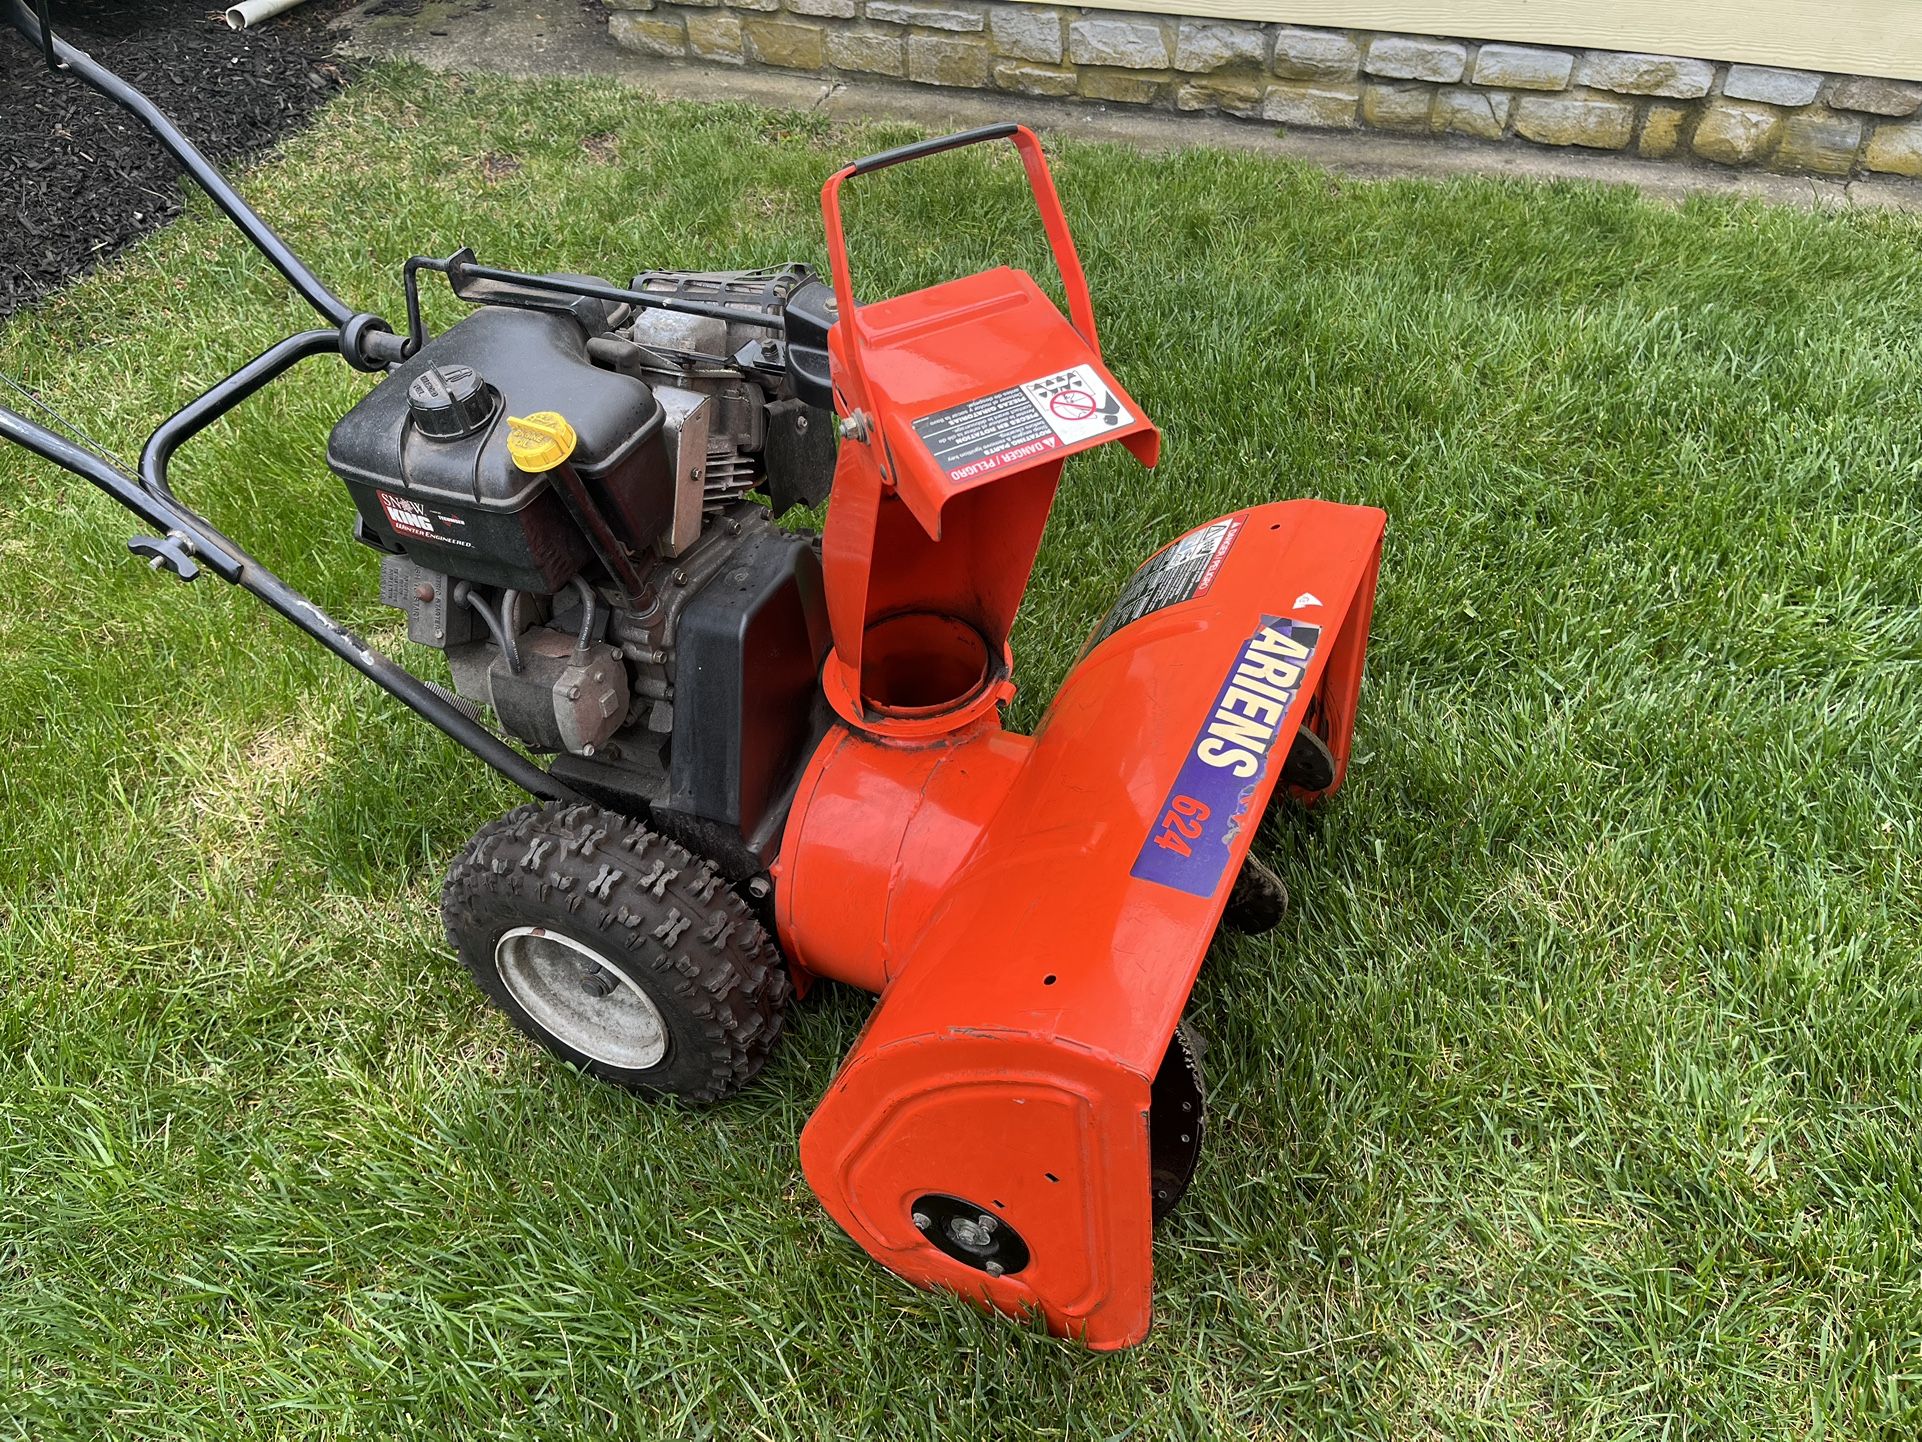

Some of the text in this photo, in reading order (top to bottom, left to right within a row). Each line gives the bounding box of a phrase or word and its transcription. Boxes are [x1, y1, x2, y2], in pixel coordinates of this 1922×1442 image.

[954, 425, 996, 444] ROTATION
[982, 428, 1052, 455] ROTATING PARTS
[1001, 444, 1044, 462] DANGER
[948, 457, 996, 480] PELIGRO
[386, 506, 434, 532] KING
[1197, 627, 1310, 778] ARIENS
[1153, 795, 1211, 858] 624
